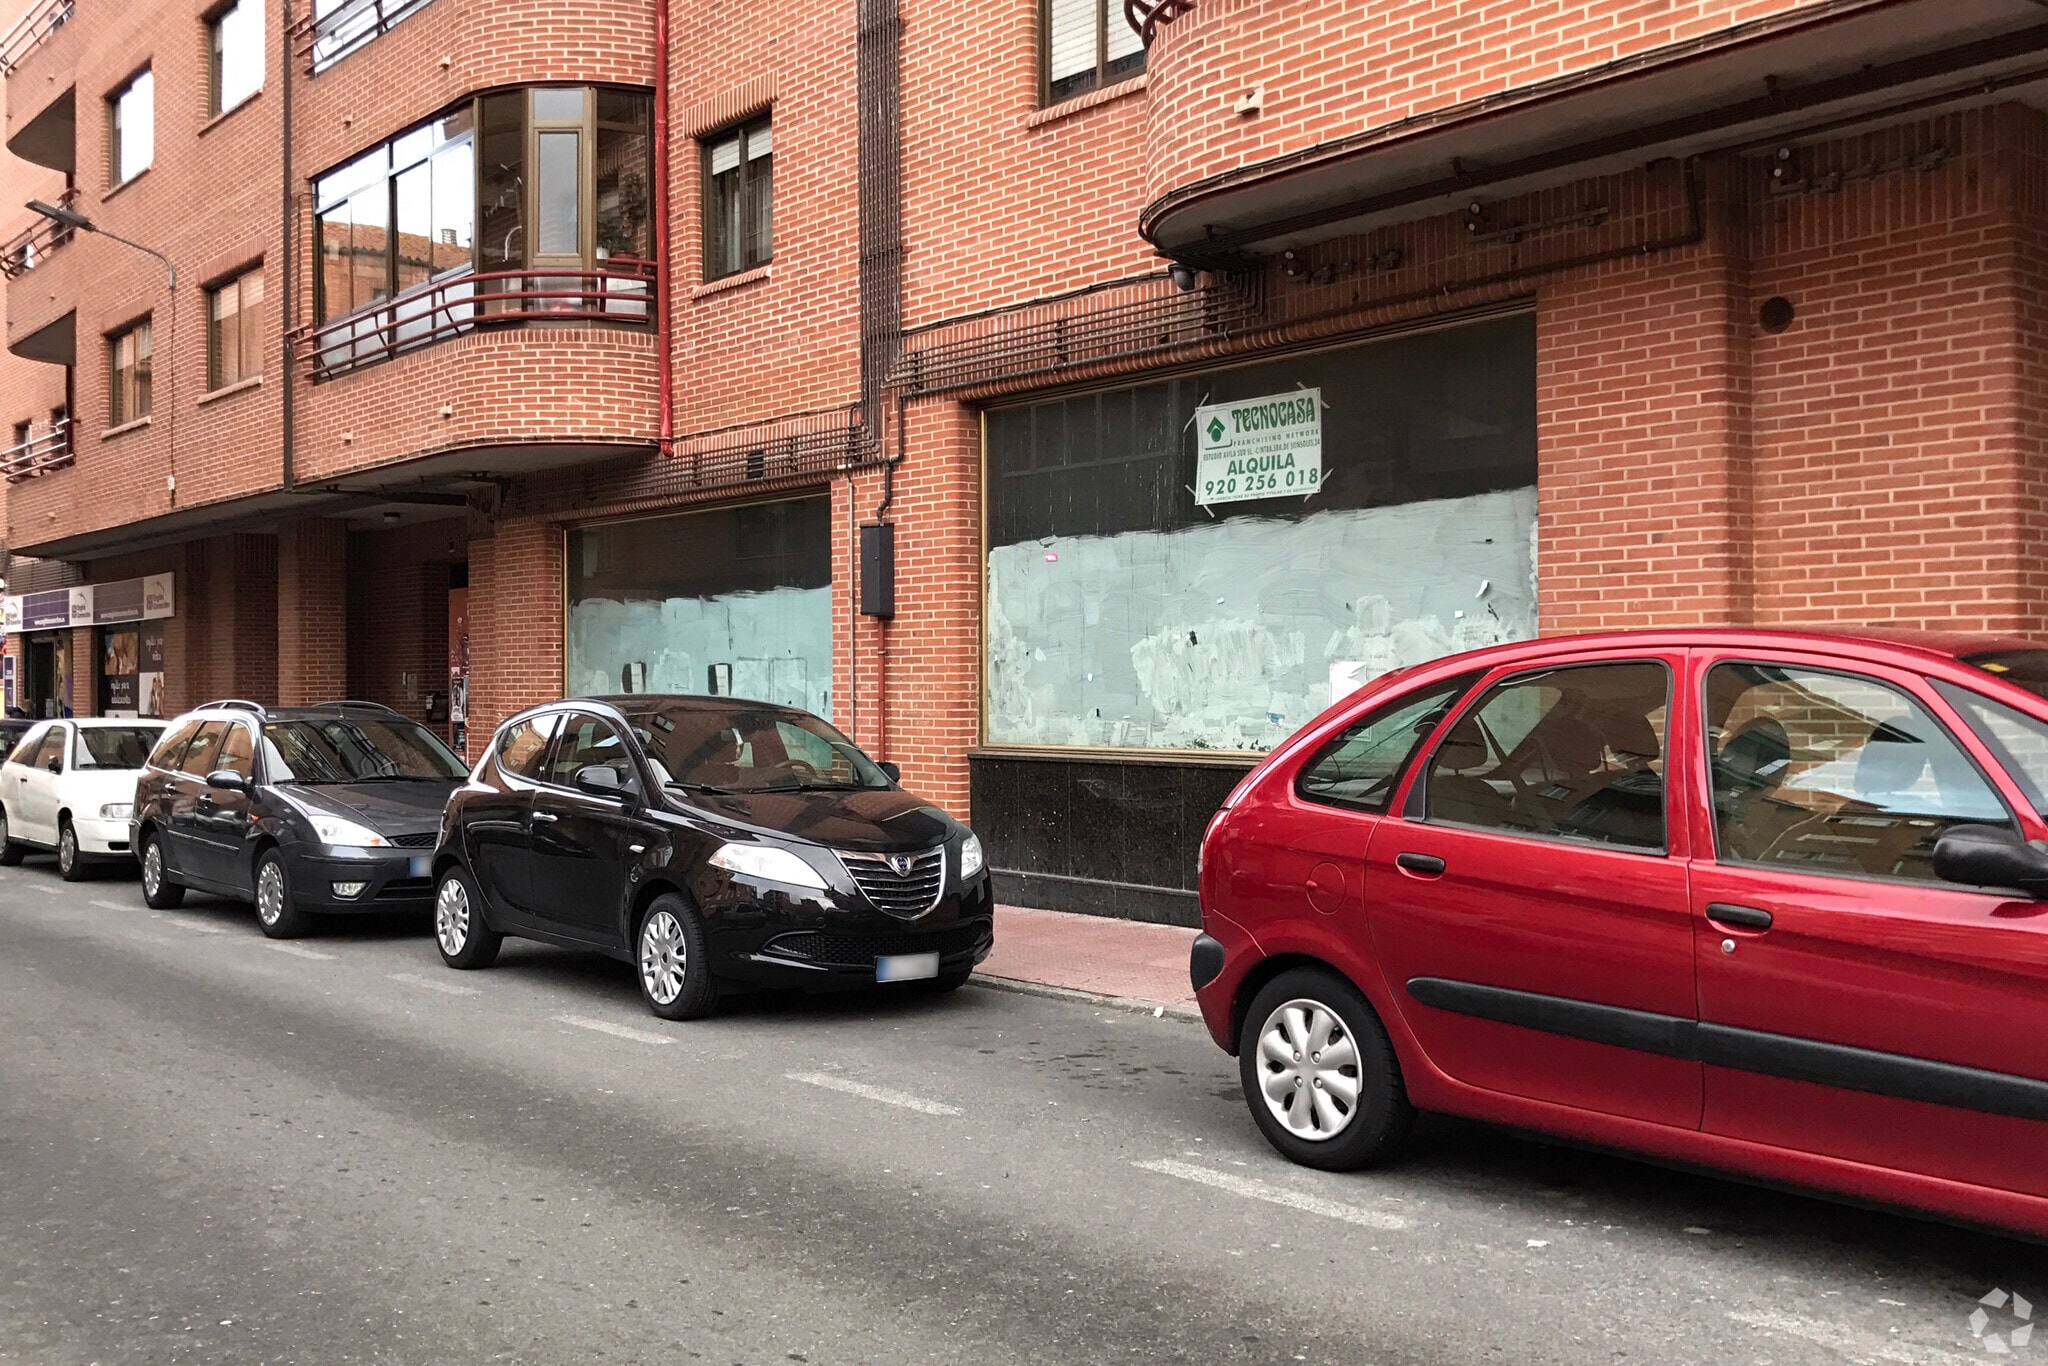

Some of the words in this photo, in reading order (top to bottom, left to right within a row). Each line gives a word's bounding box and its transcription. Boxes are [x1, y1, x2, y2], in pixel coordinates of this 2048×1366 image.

[1232, 398, 1315, 433] TECNOCASA
[1233, 434, 1282, 447] FRANCHISING
[1286, 430, 1319, 440] NETWORK
[1227, 453, 1296, 476] ALQUILA
[1205, 478, 1236, 496] 920
[1245, 473, 1277, 491] 256
[1285, 468, 1318, 487] 018
